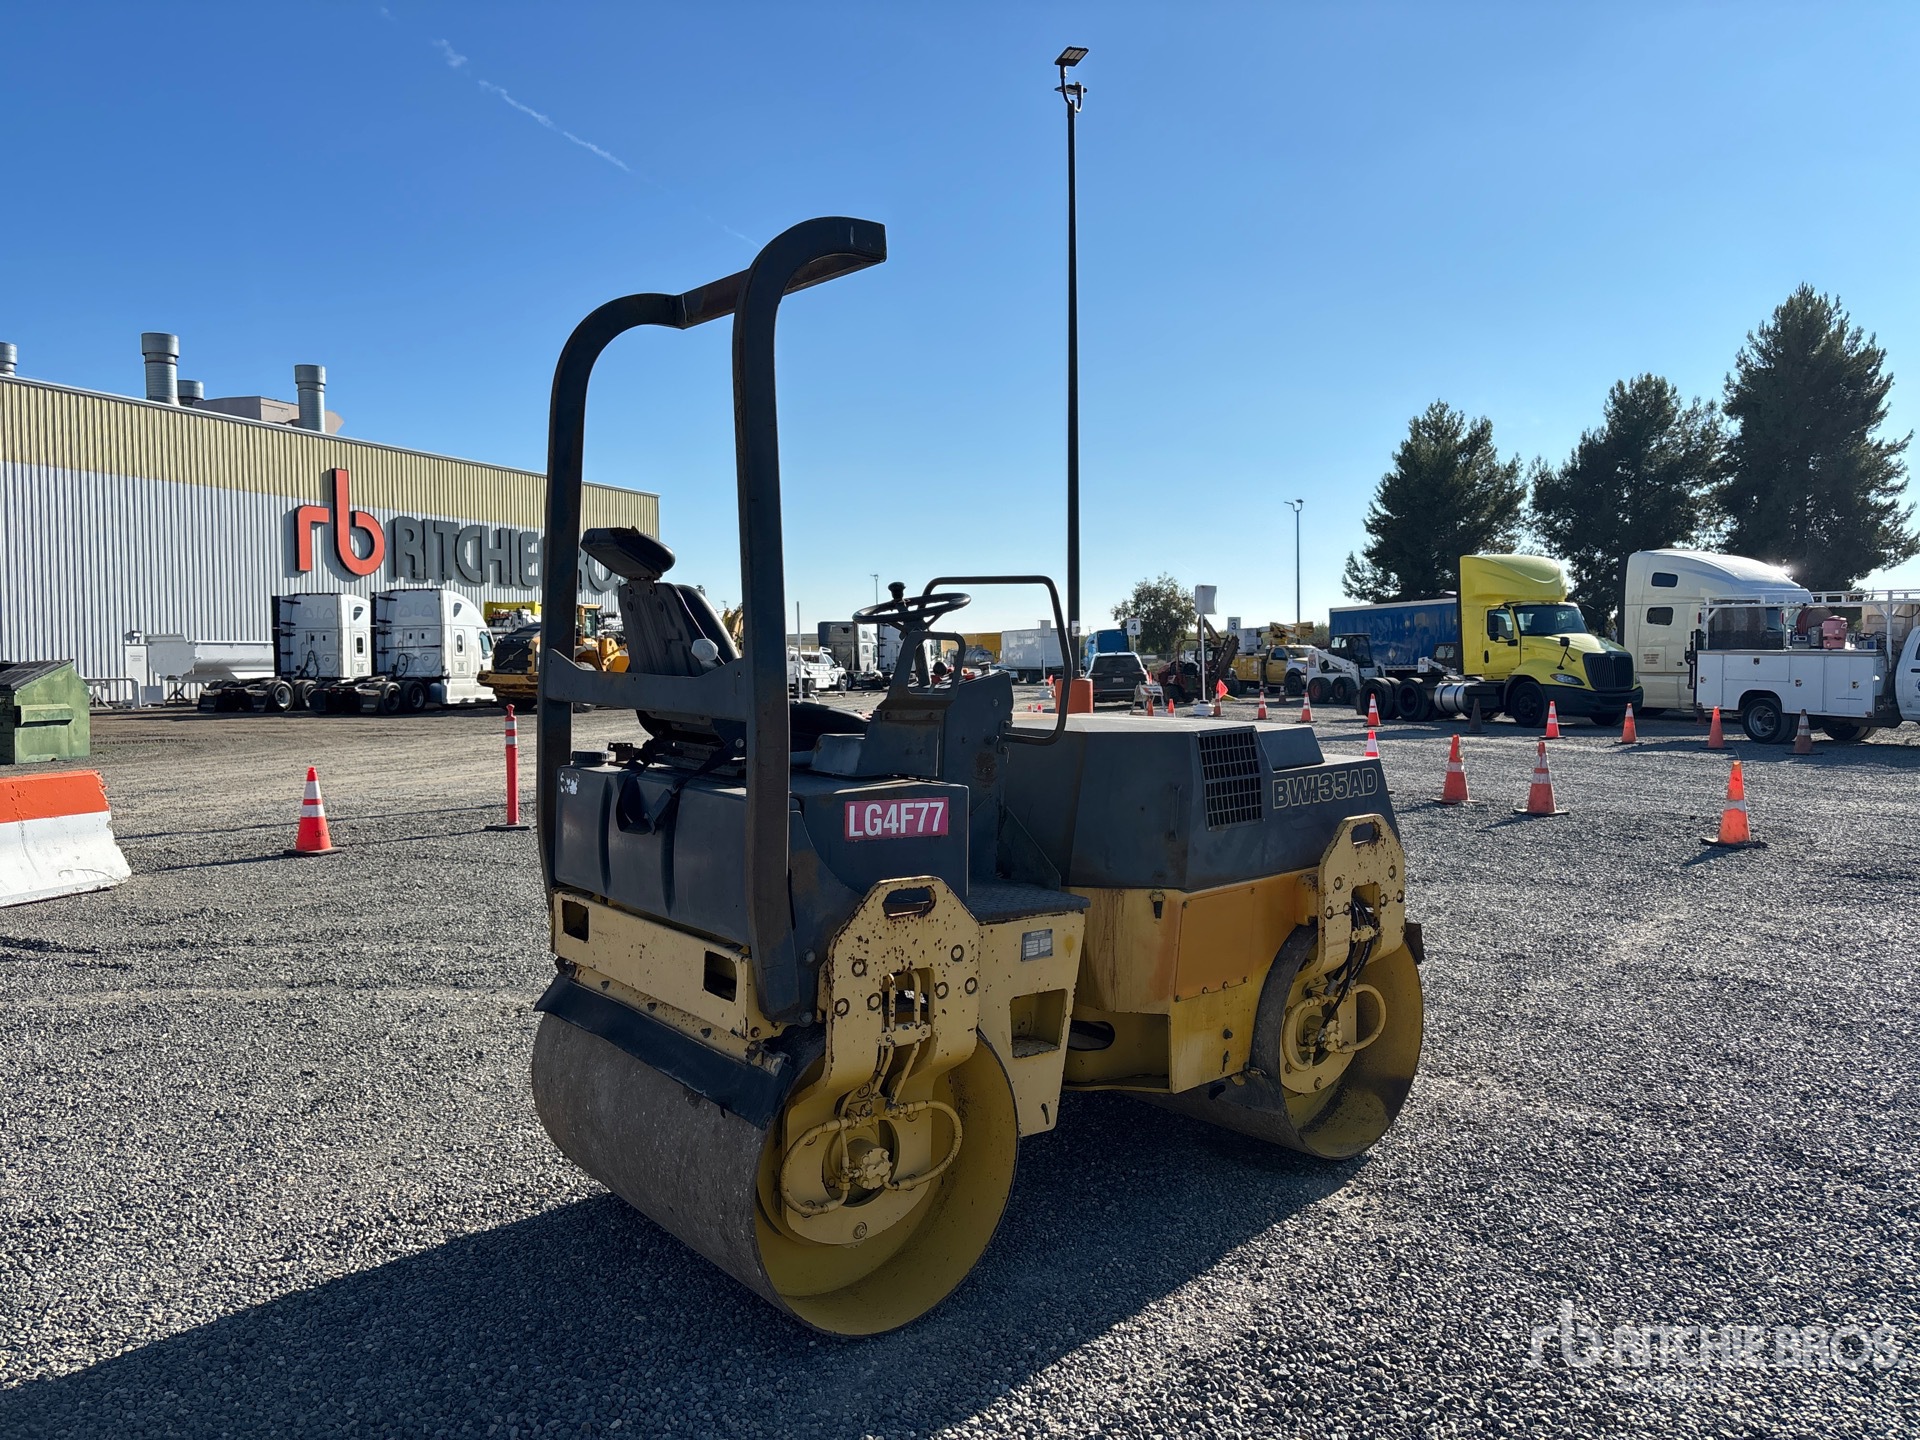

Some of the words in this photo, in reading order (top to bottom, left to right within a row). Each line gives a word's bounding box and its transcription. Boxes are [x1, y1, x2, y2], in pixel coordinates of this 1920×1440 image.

[295, 467, 385, 576] rb
[394, 516, 539, 587] RITCHIE
[1130, 622, 1137, 631] 4
[1231, 621, 1237, 630] 3
[848, 801, 945, 837] LG4F77
